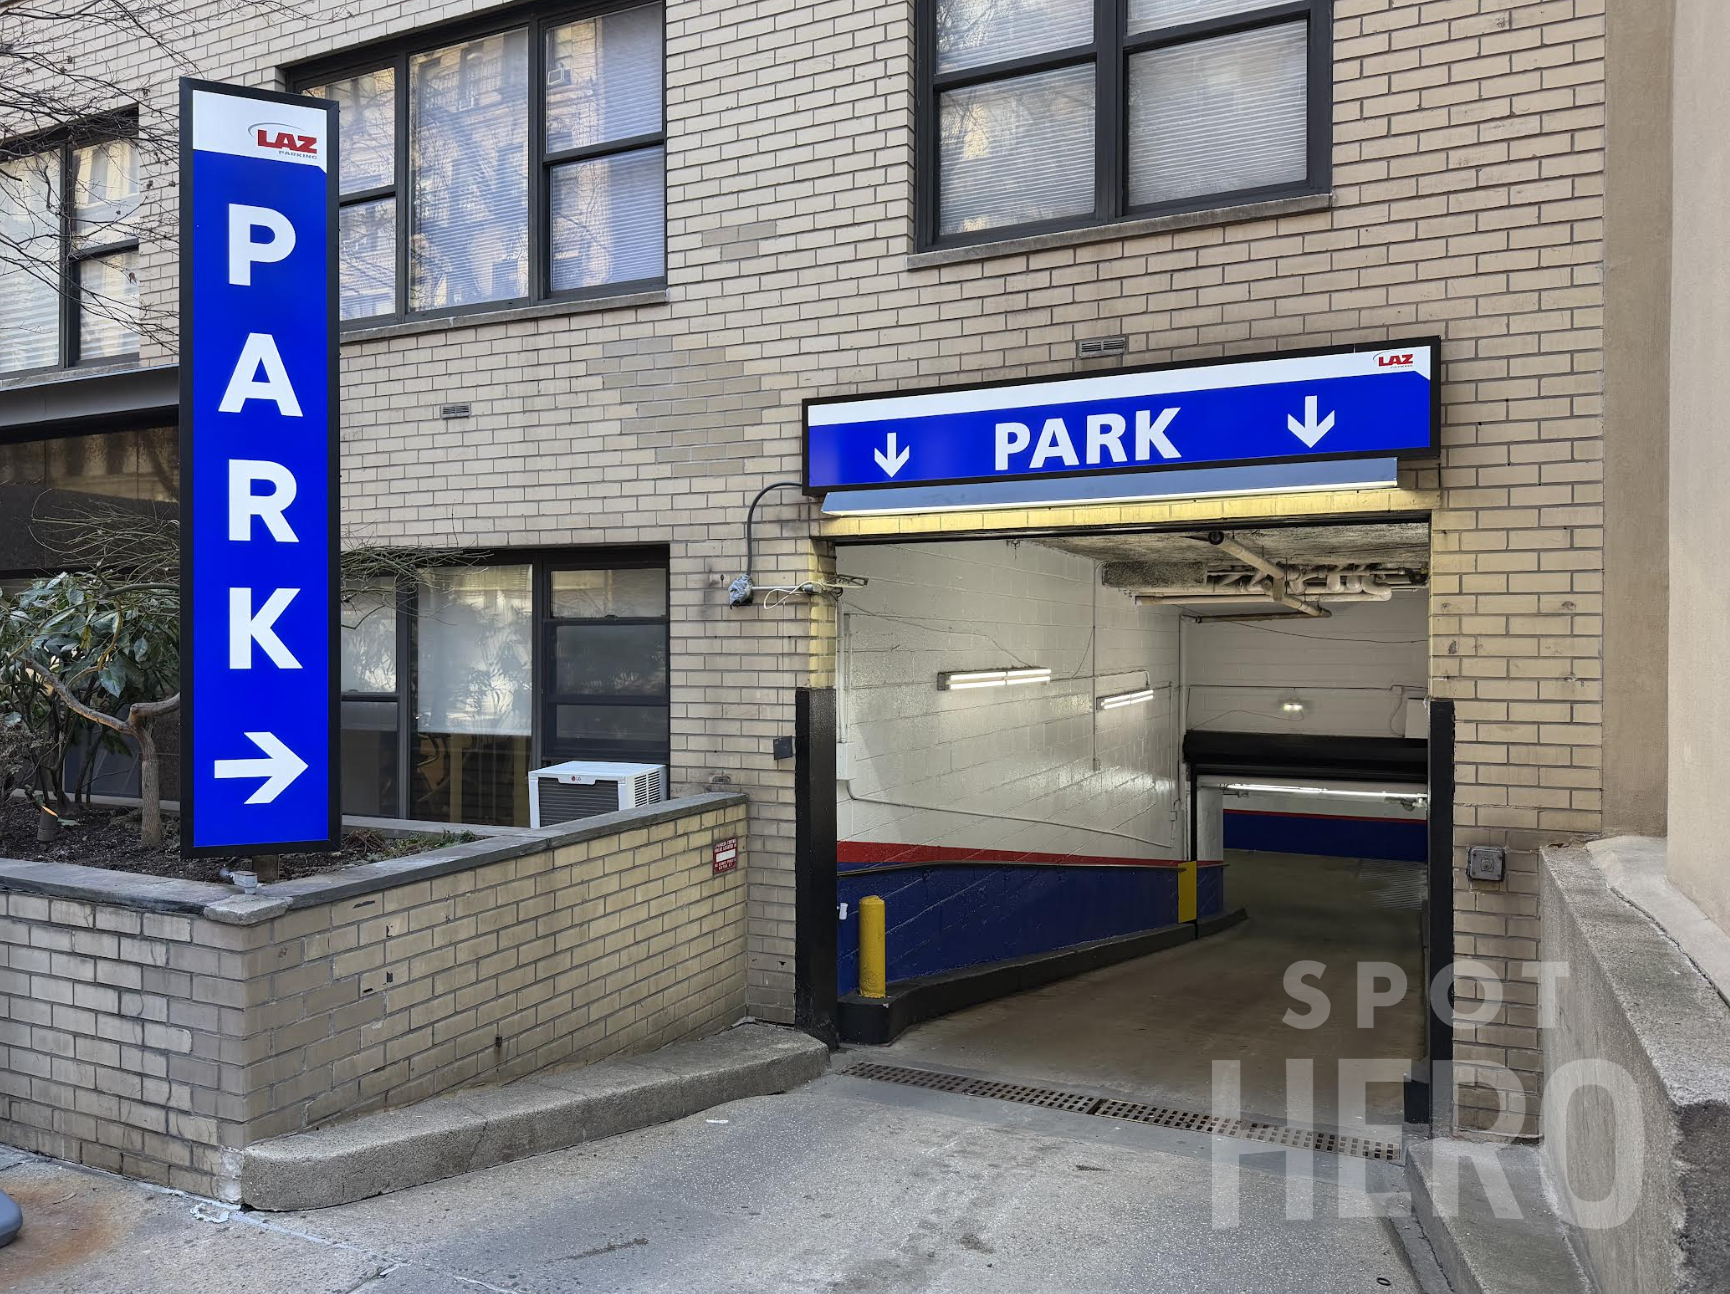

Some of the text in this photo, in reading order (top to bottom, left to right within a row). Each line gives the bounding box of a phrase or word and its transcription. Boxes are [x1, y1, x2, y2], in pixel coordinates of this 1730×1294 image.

[257, 129, 318, 154] LAZ
[278, 150, 318, 160] PARKING
[1379, 353, 1414, 367] LAZ
[218, 203, 303, 670] PARK
[994, 407, 1181, 471] PARK
